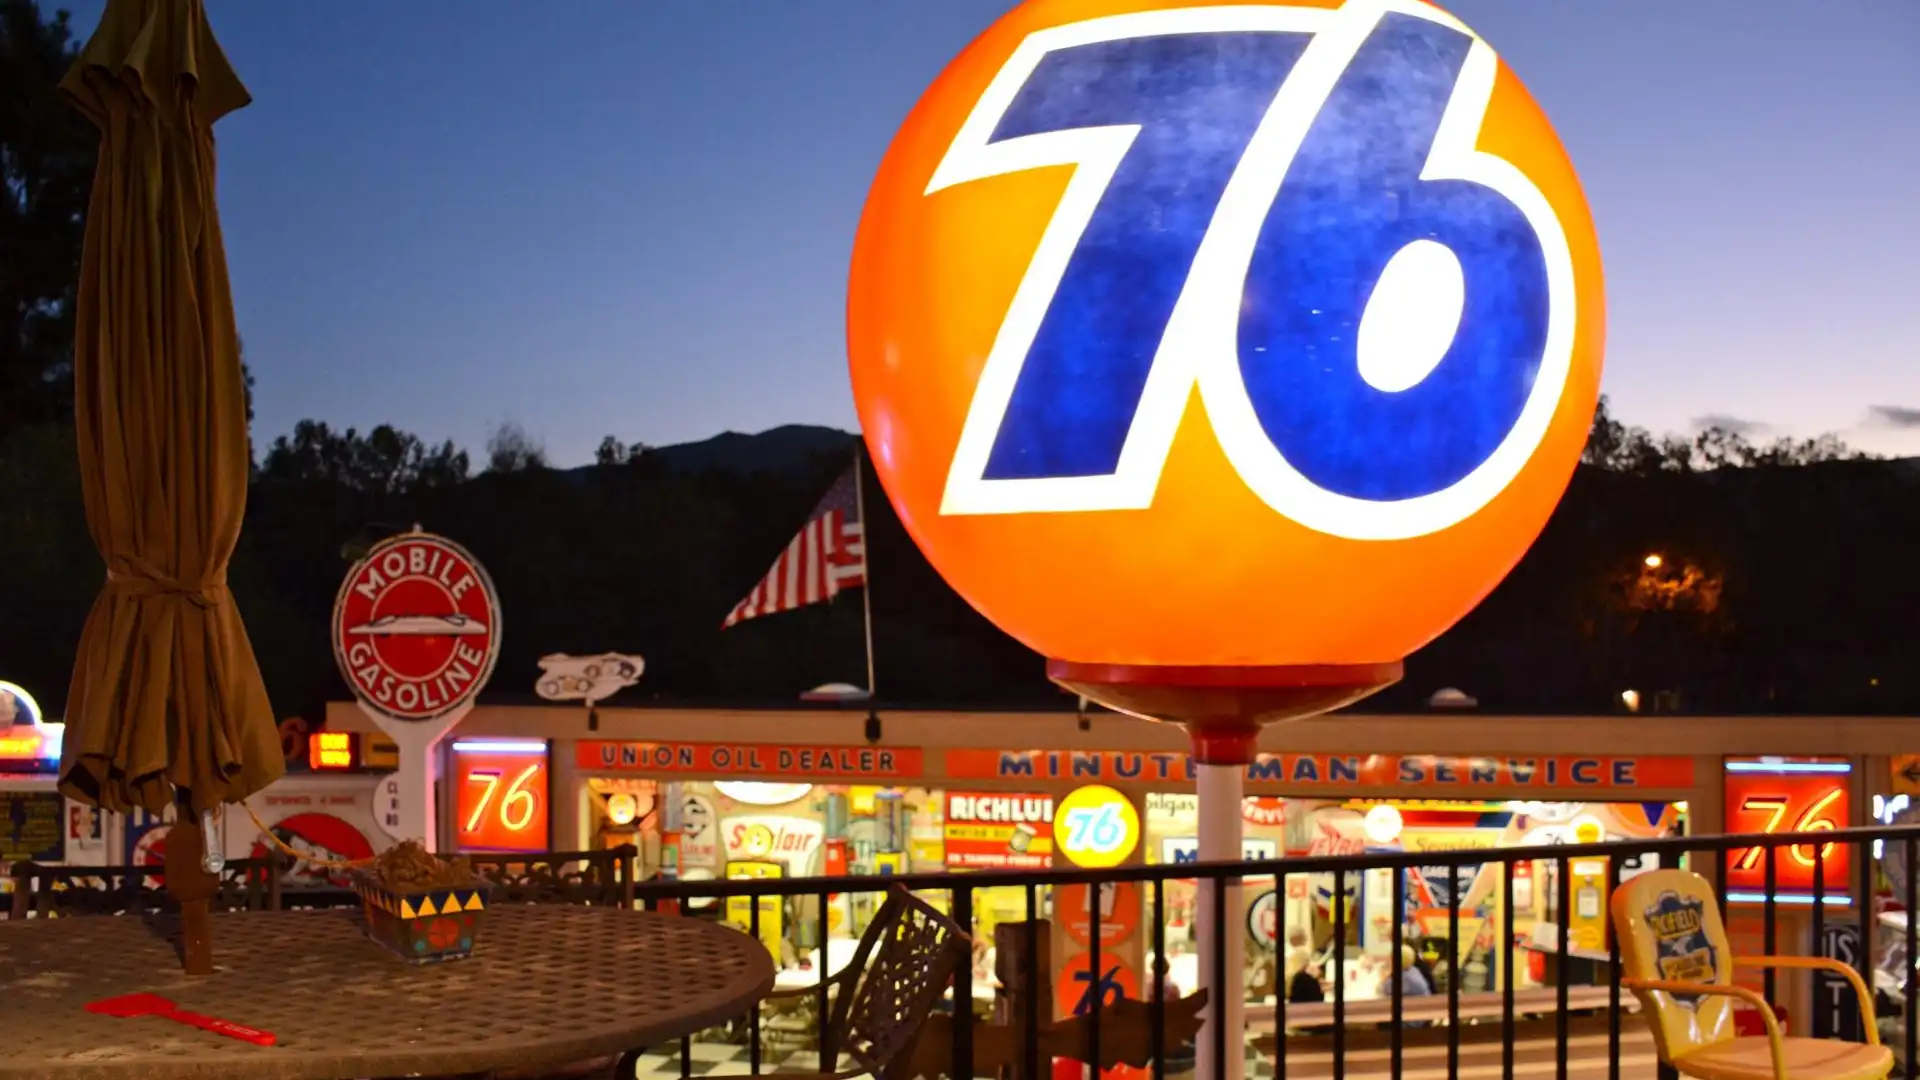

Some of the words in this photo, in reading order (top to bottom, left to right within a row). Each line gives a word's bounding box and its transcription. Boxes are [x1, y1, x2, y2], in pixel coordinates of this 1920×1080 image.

[924, 0, 1576, 541] 76
[355, 546, 476, 600] MOBILE
[349, 642, 483, 709] GASOLINE
[602, 745, 694, 766] UNION
[711, 747, 764, 768] OIL
[778, 749, 896, 772] DEALER
[1246, 756, 1360, 783] MAN
[1399, 757, 1638, 786] SERVICE
[463, 763, 542, 832] 76
[1065, 802, 1129, 852] 76
[1736, 788, 1843, 870] 76
[1073, 965, 1124, 1016] 76
